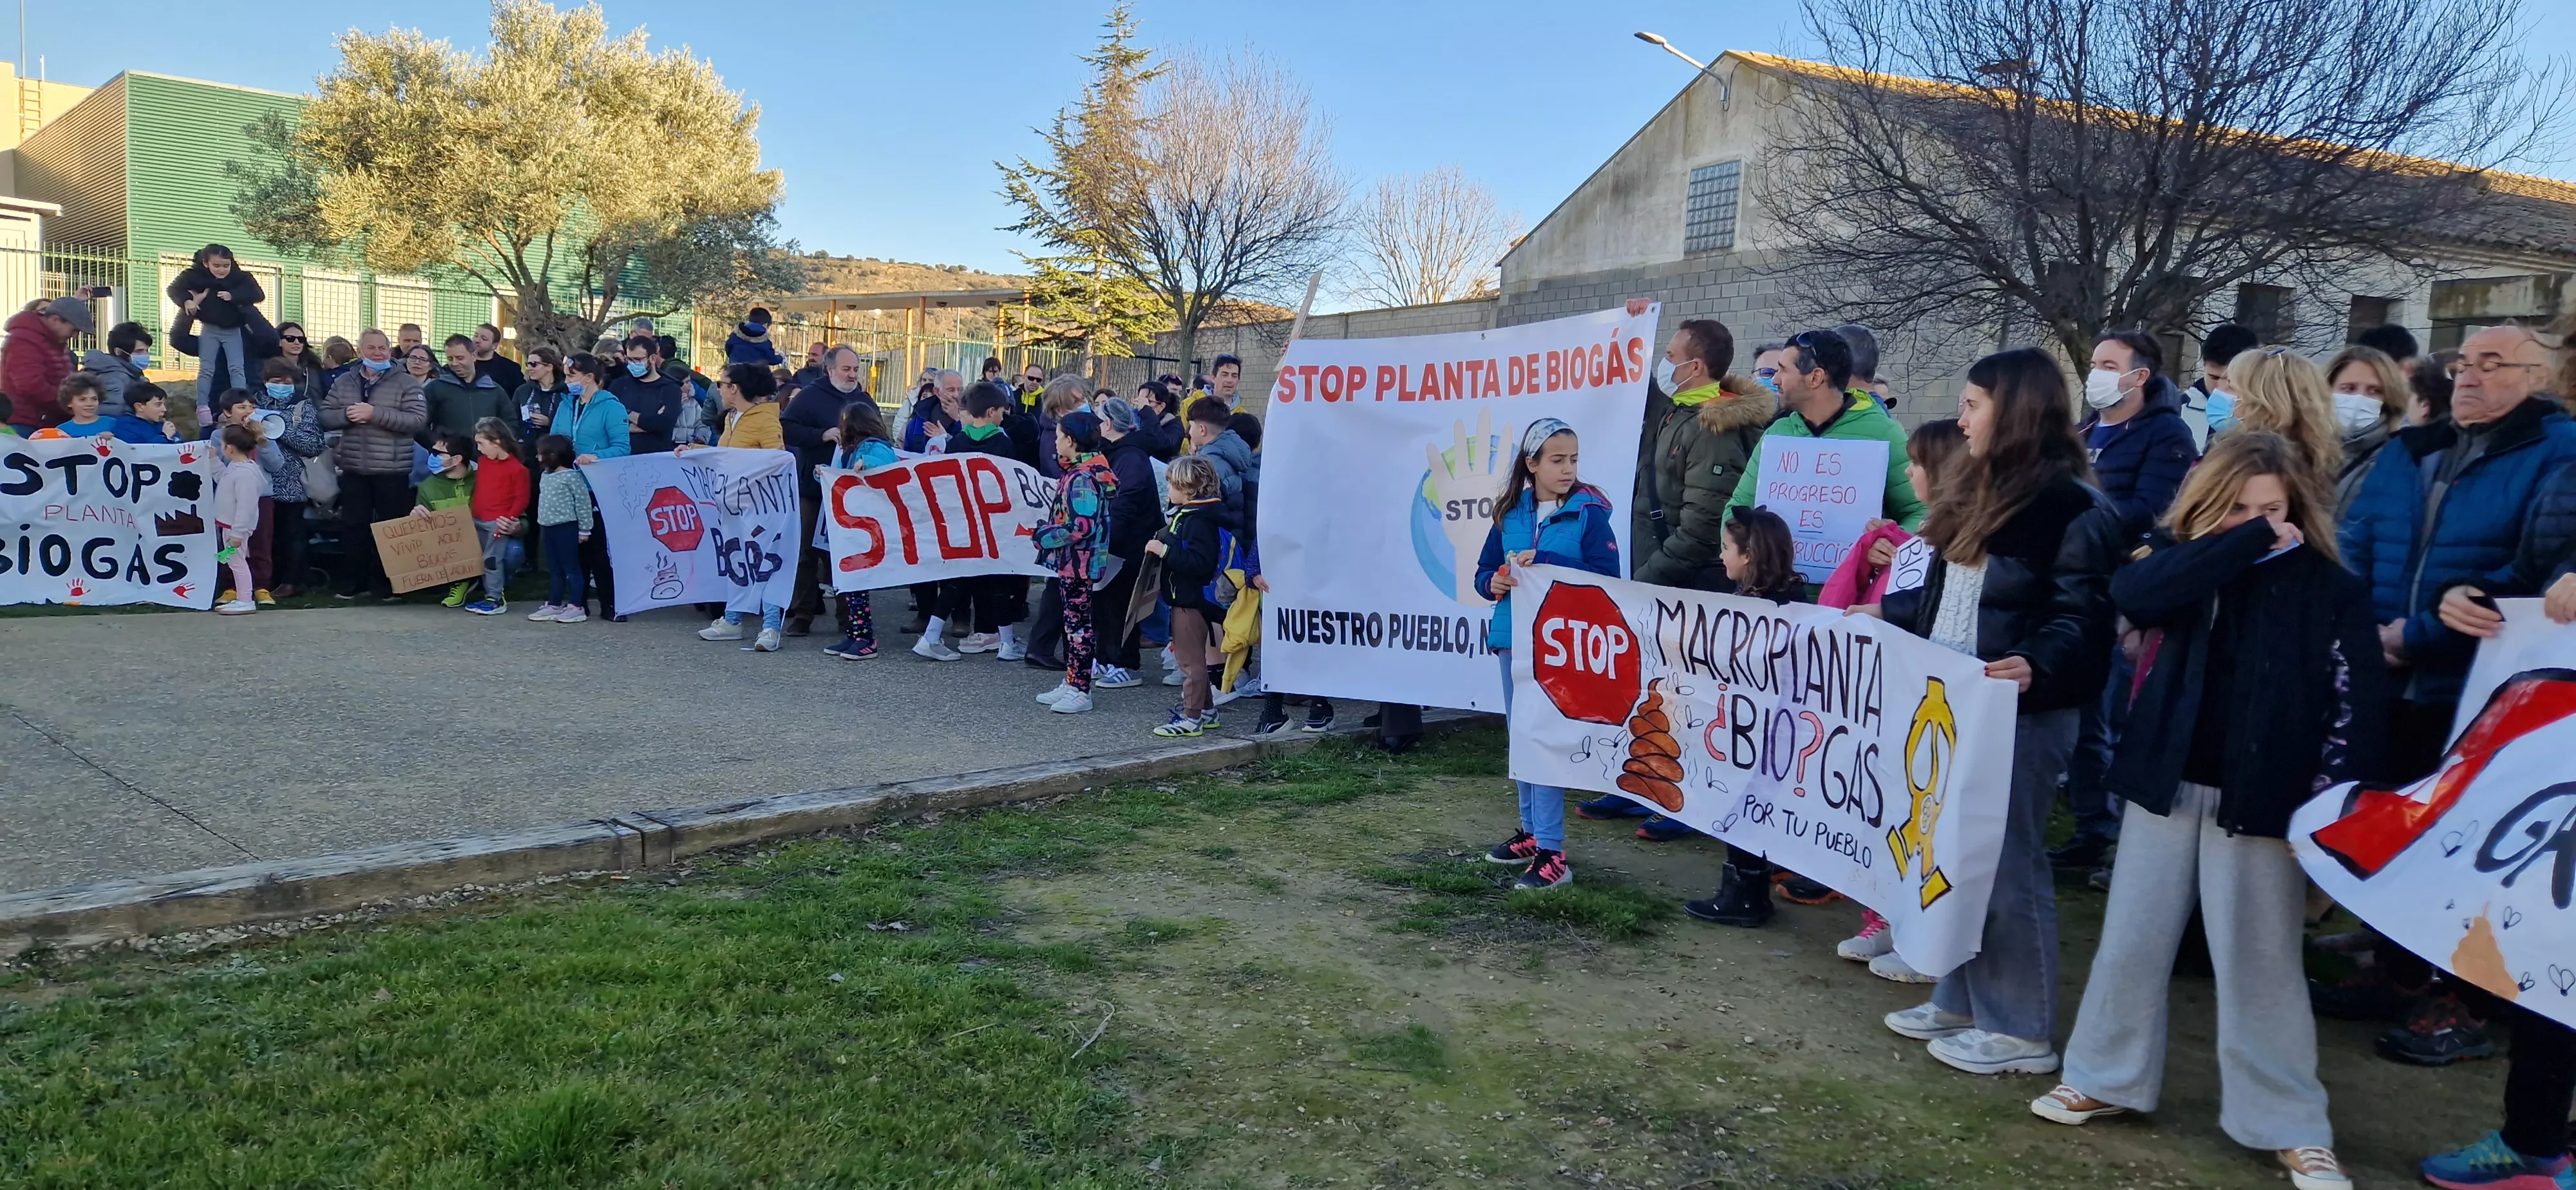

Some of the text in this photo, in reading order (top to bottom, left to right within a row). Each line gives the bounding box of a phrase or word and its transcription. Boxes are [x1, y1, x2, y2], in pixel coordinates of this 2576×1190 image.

[1277, 326, 1645, 403] STOP PLANTA DE BIOGÁS
[0, 452, 162, 504] STOP
[1777, 451, 1842, 476] NO ES
[1446, 497, 1498, 521] STO
[1768, 482, 1857, 505] PROGRESO
[44, 504, 137, 529] PLANTA
[383, 512, 457, 540] QUEREMOS
[650, 504, 697, 536] STOP
[831, 457, 1012, 572] STOP
[1799, 510, 1824, 529] ES
[402, 573, 433, 588] FUERA
[1896, 539, 1924, 589] BIO
[1278, 607, 1383, 648] NUESTRO
[1388, 613, 1474, 659] PUEBLO,
[1542, 617, 1629, 680] STOP
[1655, 597, 1883, 737] MACROPLANTA
[1743, 794, 1872, 869] POR TU PUEBLO
